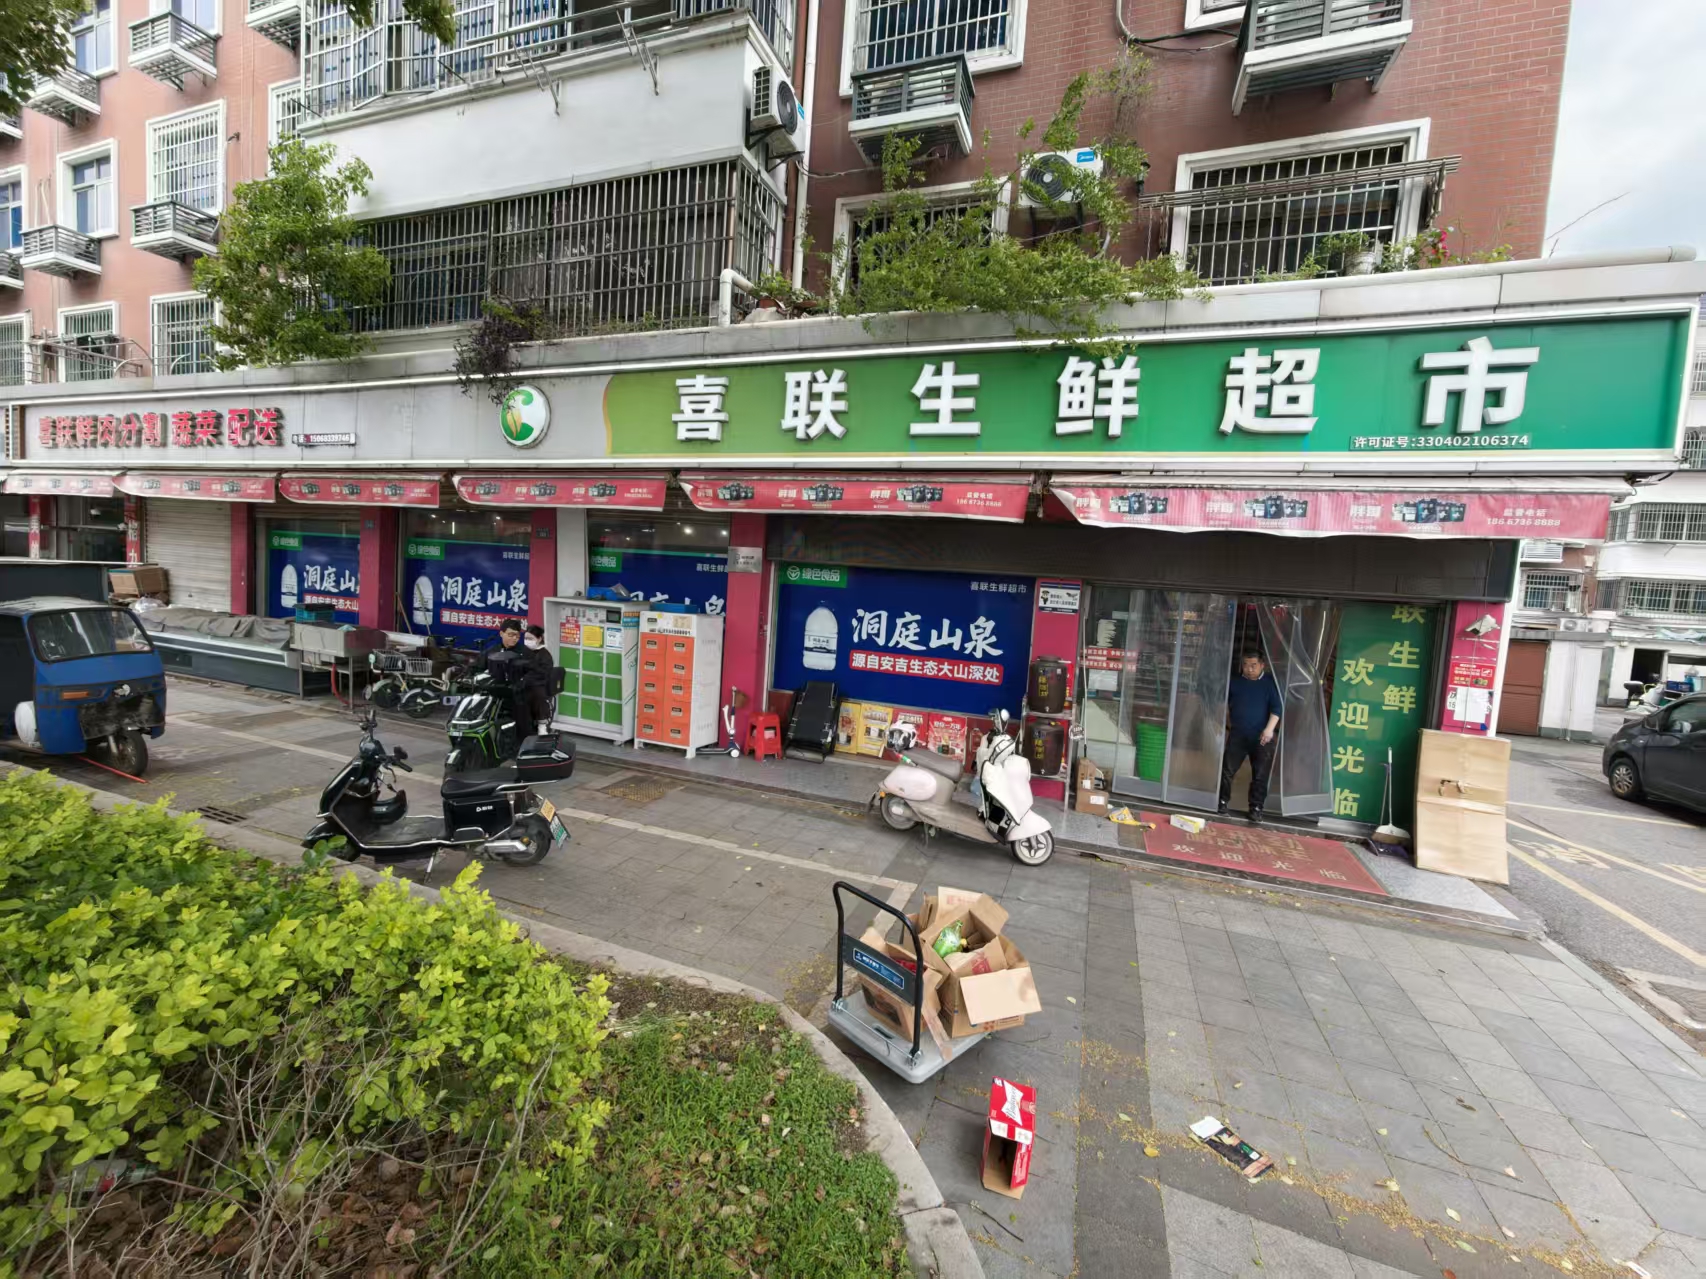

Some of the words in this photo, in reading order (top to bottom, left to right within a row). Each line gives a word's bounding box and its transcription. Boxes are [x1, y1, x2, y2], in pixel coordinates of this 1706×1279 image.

[671, 336, 1540, 442] 喜联生鲜超市
[171, 410, 218, 446] 蔬菜
[227, 408, 278, 446] 配送
[1353, 435, 1529, 448] 许可证号:330402106374
[303, 564, 359, 594] 洞庭山
[440, 575, 529, 612] 洞庭山泉
[970, 581, 1027, 594] 喜联生鲜超市
[851, 608, 1004, 659] 洞庭山泉
[852, 652, 1000, 683] 源自安吉生态大山深处
[1332, 658, 1375, 817] 欢迎光临
